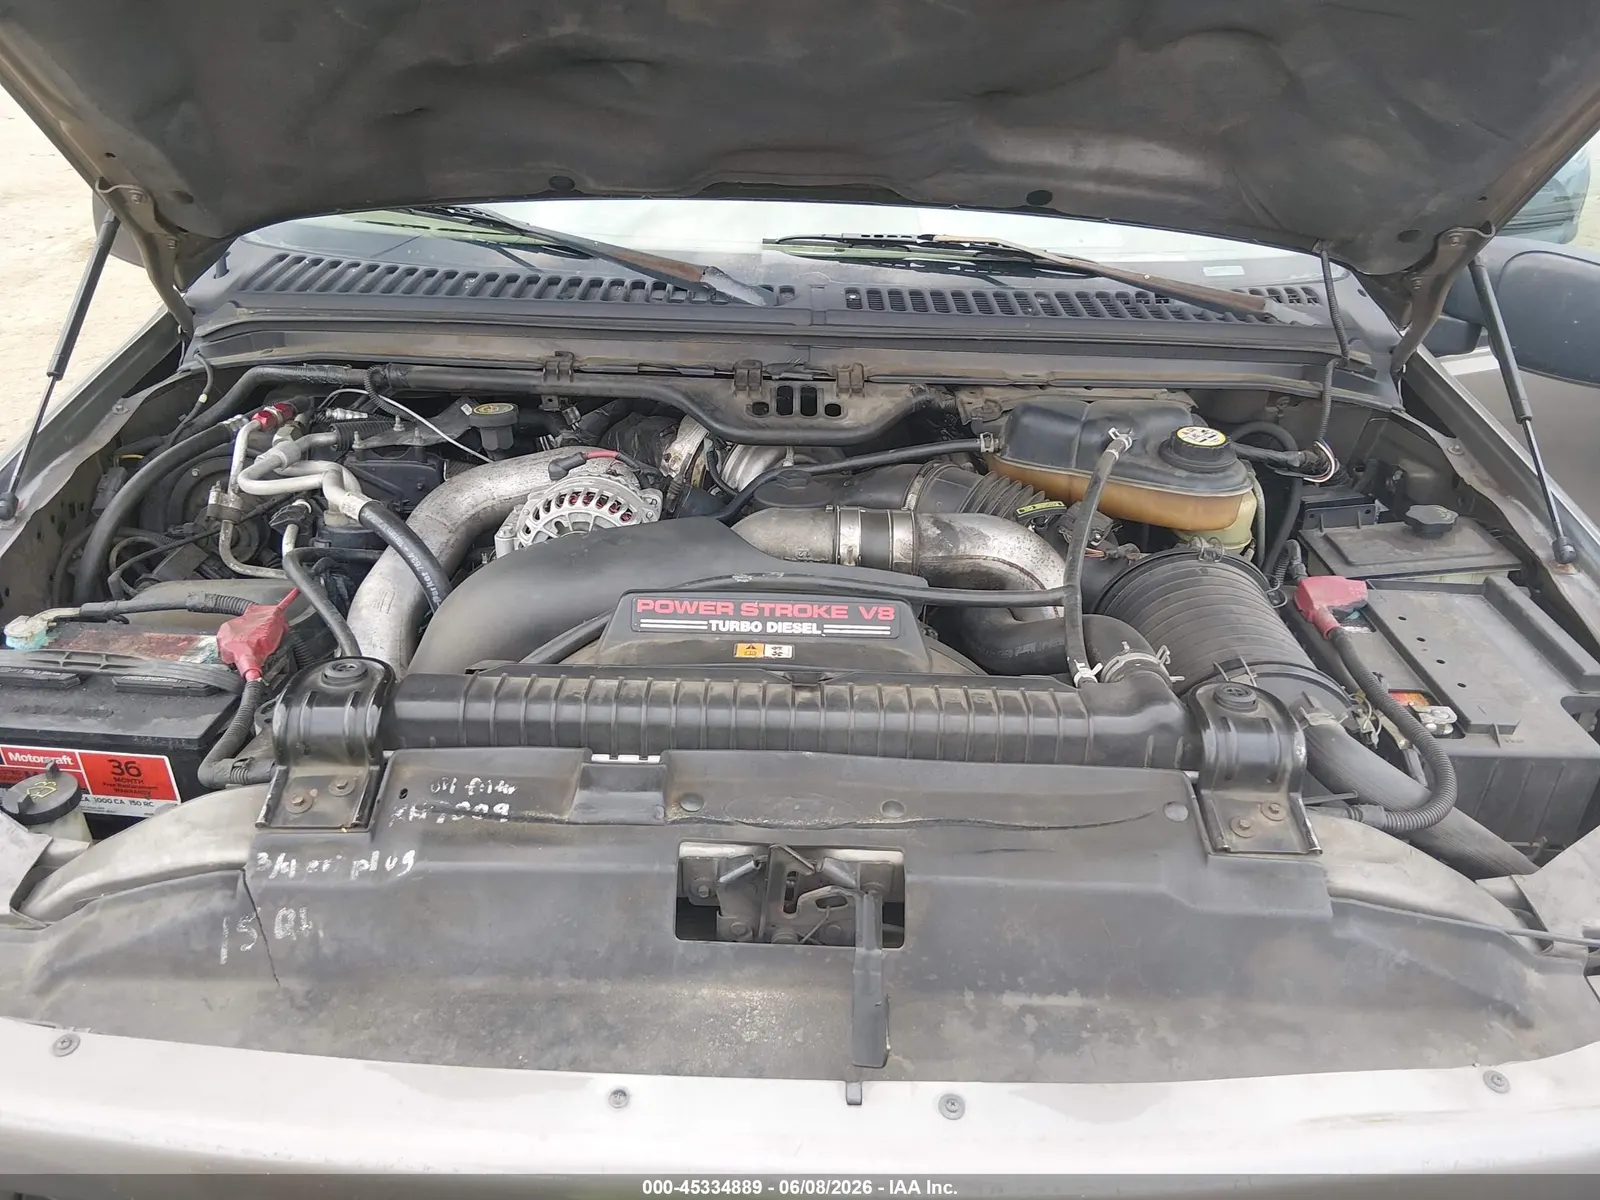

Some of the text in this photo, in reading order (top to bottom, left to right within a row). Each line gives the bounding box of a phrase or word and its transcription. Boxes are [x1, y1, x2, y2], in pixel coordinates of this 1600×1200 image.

[636, 599, 895, 620] POWER STROKE V8
[709, 620, 822, 635] TURBO DIESEL
[108, 759, 142, 777] 36
[351, 850, 415, 880] plug
